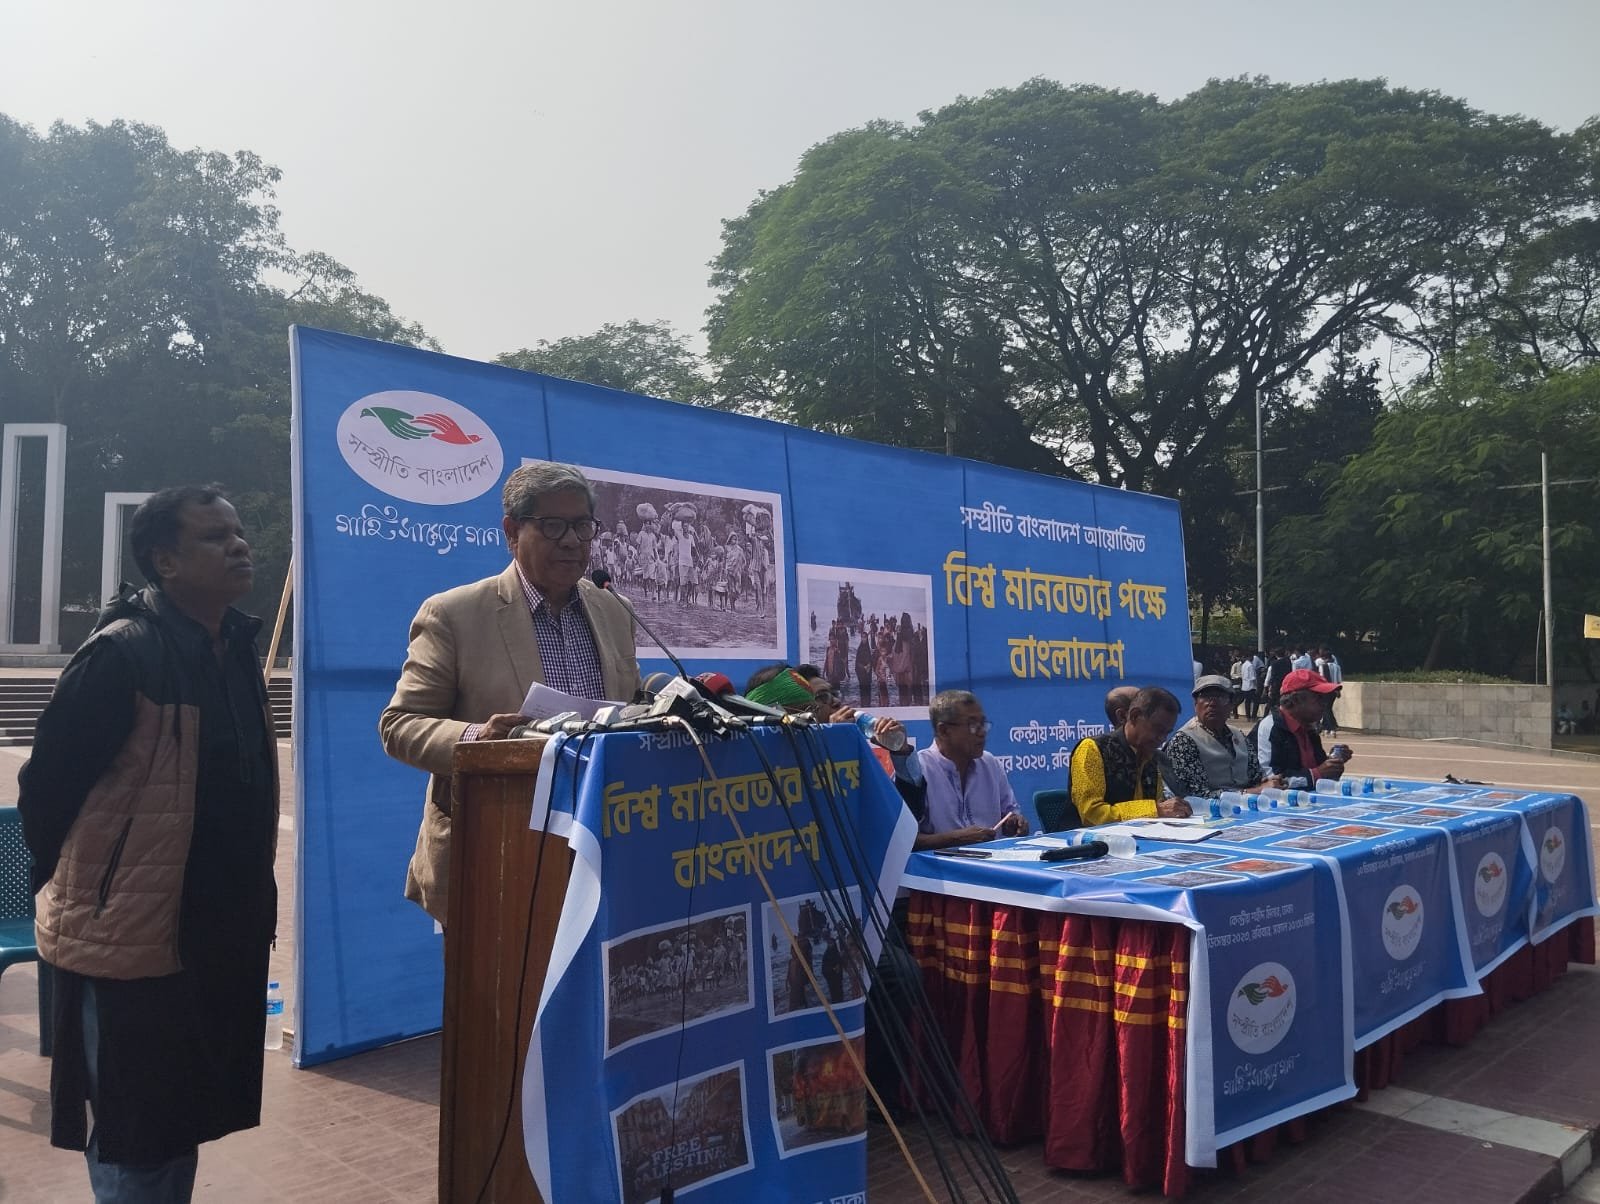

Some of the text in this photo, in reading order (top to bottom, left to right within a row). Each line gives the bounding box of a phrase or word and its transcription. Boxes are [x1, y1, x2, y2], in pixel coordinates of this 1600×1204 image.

[349, 434, 494, 486] সম্প্রীতি বাংলাদেশ
[960, 501, 1146, 553] সম্প্রীতি বাংলাদেশ আয়োজিত
[943, 550, 1167, 621] বিশ্ব মানবতার পক্ষে
[1007, 634, 1125, 680] বাংলাদেশ
[1009, 719, 1047, 745] কেন্দ্রীয়
[1049, 719, 1076, 742] শহীদ
[603, 781, 661, 839] বিশ্ব
[669, 767, 803, 822] মানবতার
[672, 821, 820, 889] বাংলাদেশ
[651, 1136, 702, 1165] FREE
